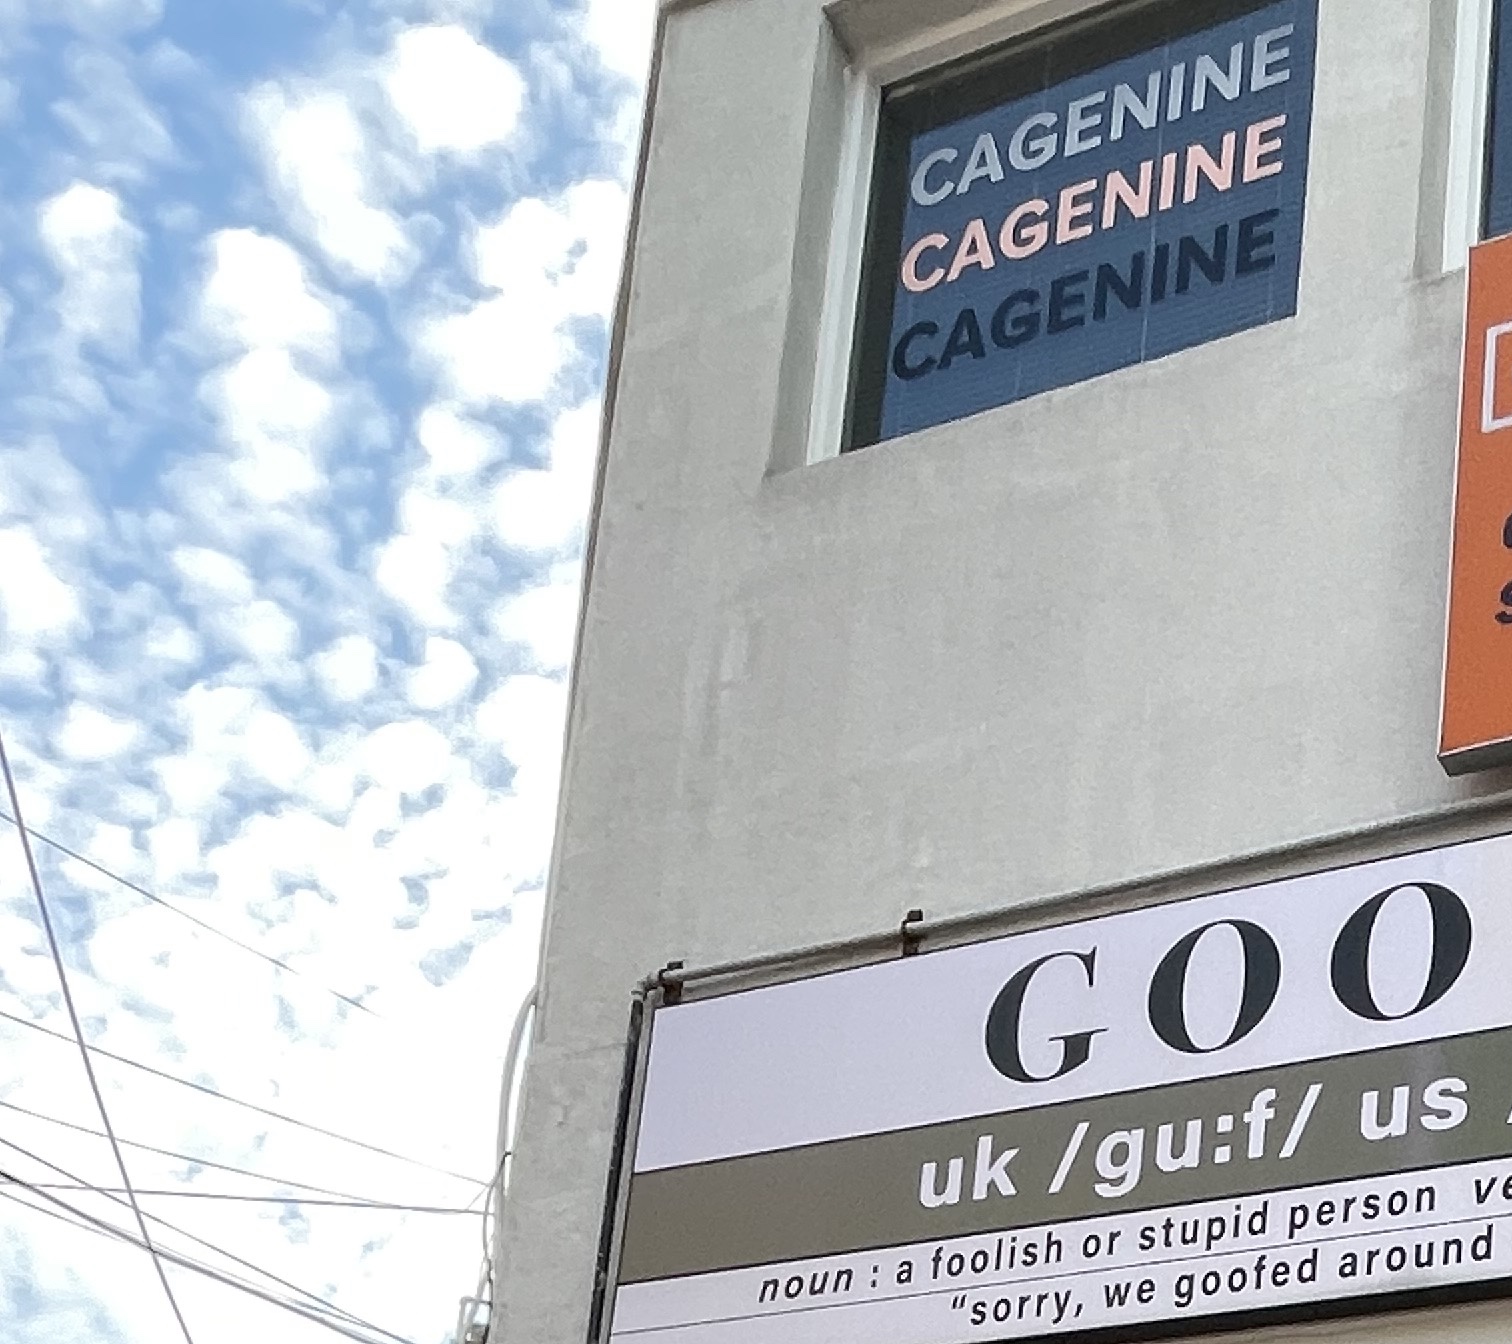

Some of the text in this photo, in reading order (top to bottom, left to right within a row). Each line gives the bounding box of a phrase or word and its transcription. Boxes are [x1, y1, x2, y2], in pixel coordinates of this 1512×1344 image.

[911, 23, 1294, 206] CAGENINE
[901, 114, 1287, 292] CAGENINE
[892, 208, 1280, 381] CAGENINE
[919, 1134, 1019, 1209] uk
[1360, 1076, 1469, 1142] us
[758, 1264, 854, 1304] noun
[896, 1258, 914, 1284] a
[931, 1231, 1064, 1279] foolish
[1082, 1229, 1121, 1259] or
[1138, 1200, 1269, 1250] stupid
[1287, 1184, 1437, 1237] person
[1103, 1276, 1157, 1309] we
[1173, 1249, 1319, 1308] goofed
[1338, 1224, 1494, 1279] around
